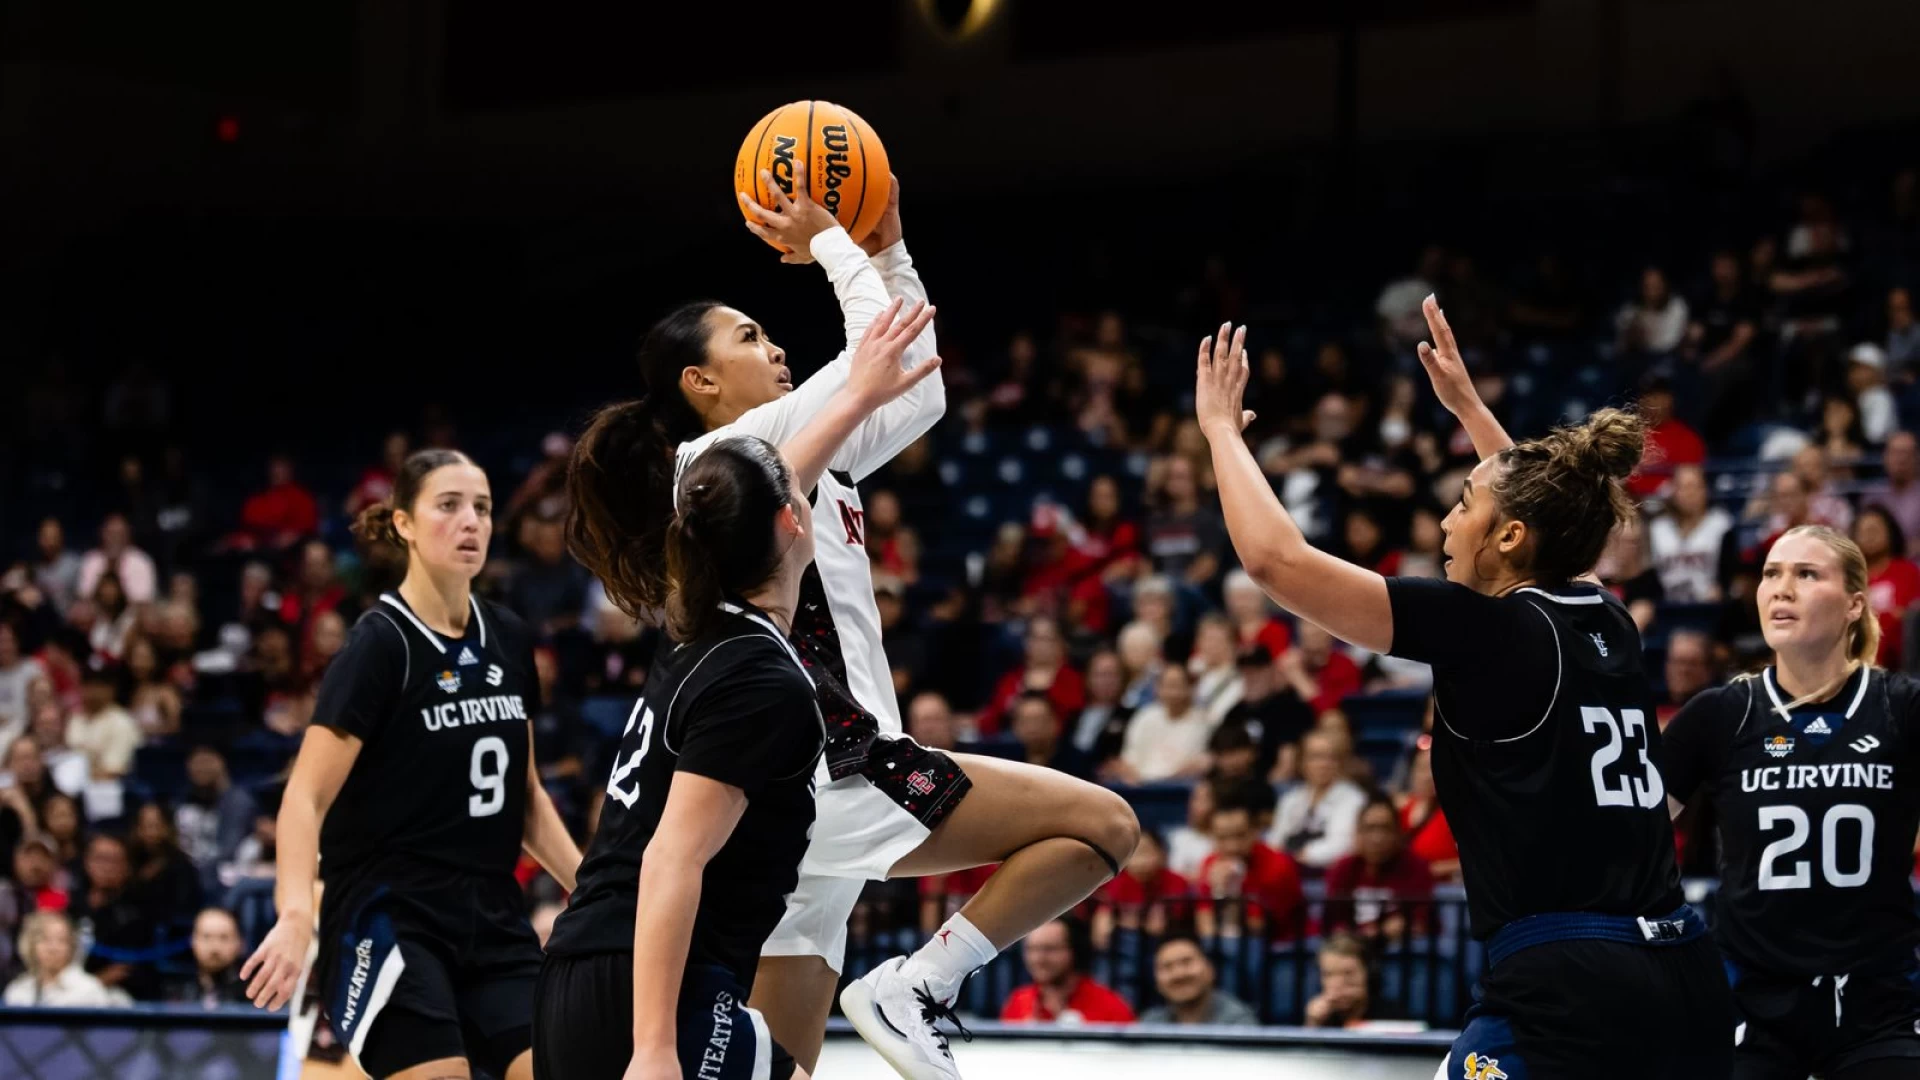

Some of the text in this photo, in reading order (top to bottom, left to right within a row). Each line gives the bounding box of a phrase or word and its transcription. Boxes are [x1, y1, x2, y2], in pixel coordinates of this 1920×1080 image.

[773, 135, 797, 212] NCA
[420, 695, 528, 732] UC IRVINE
[469, 736, 509, 817] 9
[1579, 705, 1664, 809] 23
[1741, 763, 1894, 793] UC IRVINE
[1758, 803, 1876, 890] 20
[340, 937, 373, 1032] ANTEATERS
